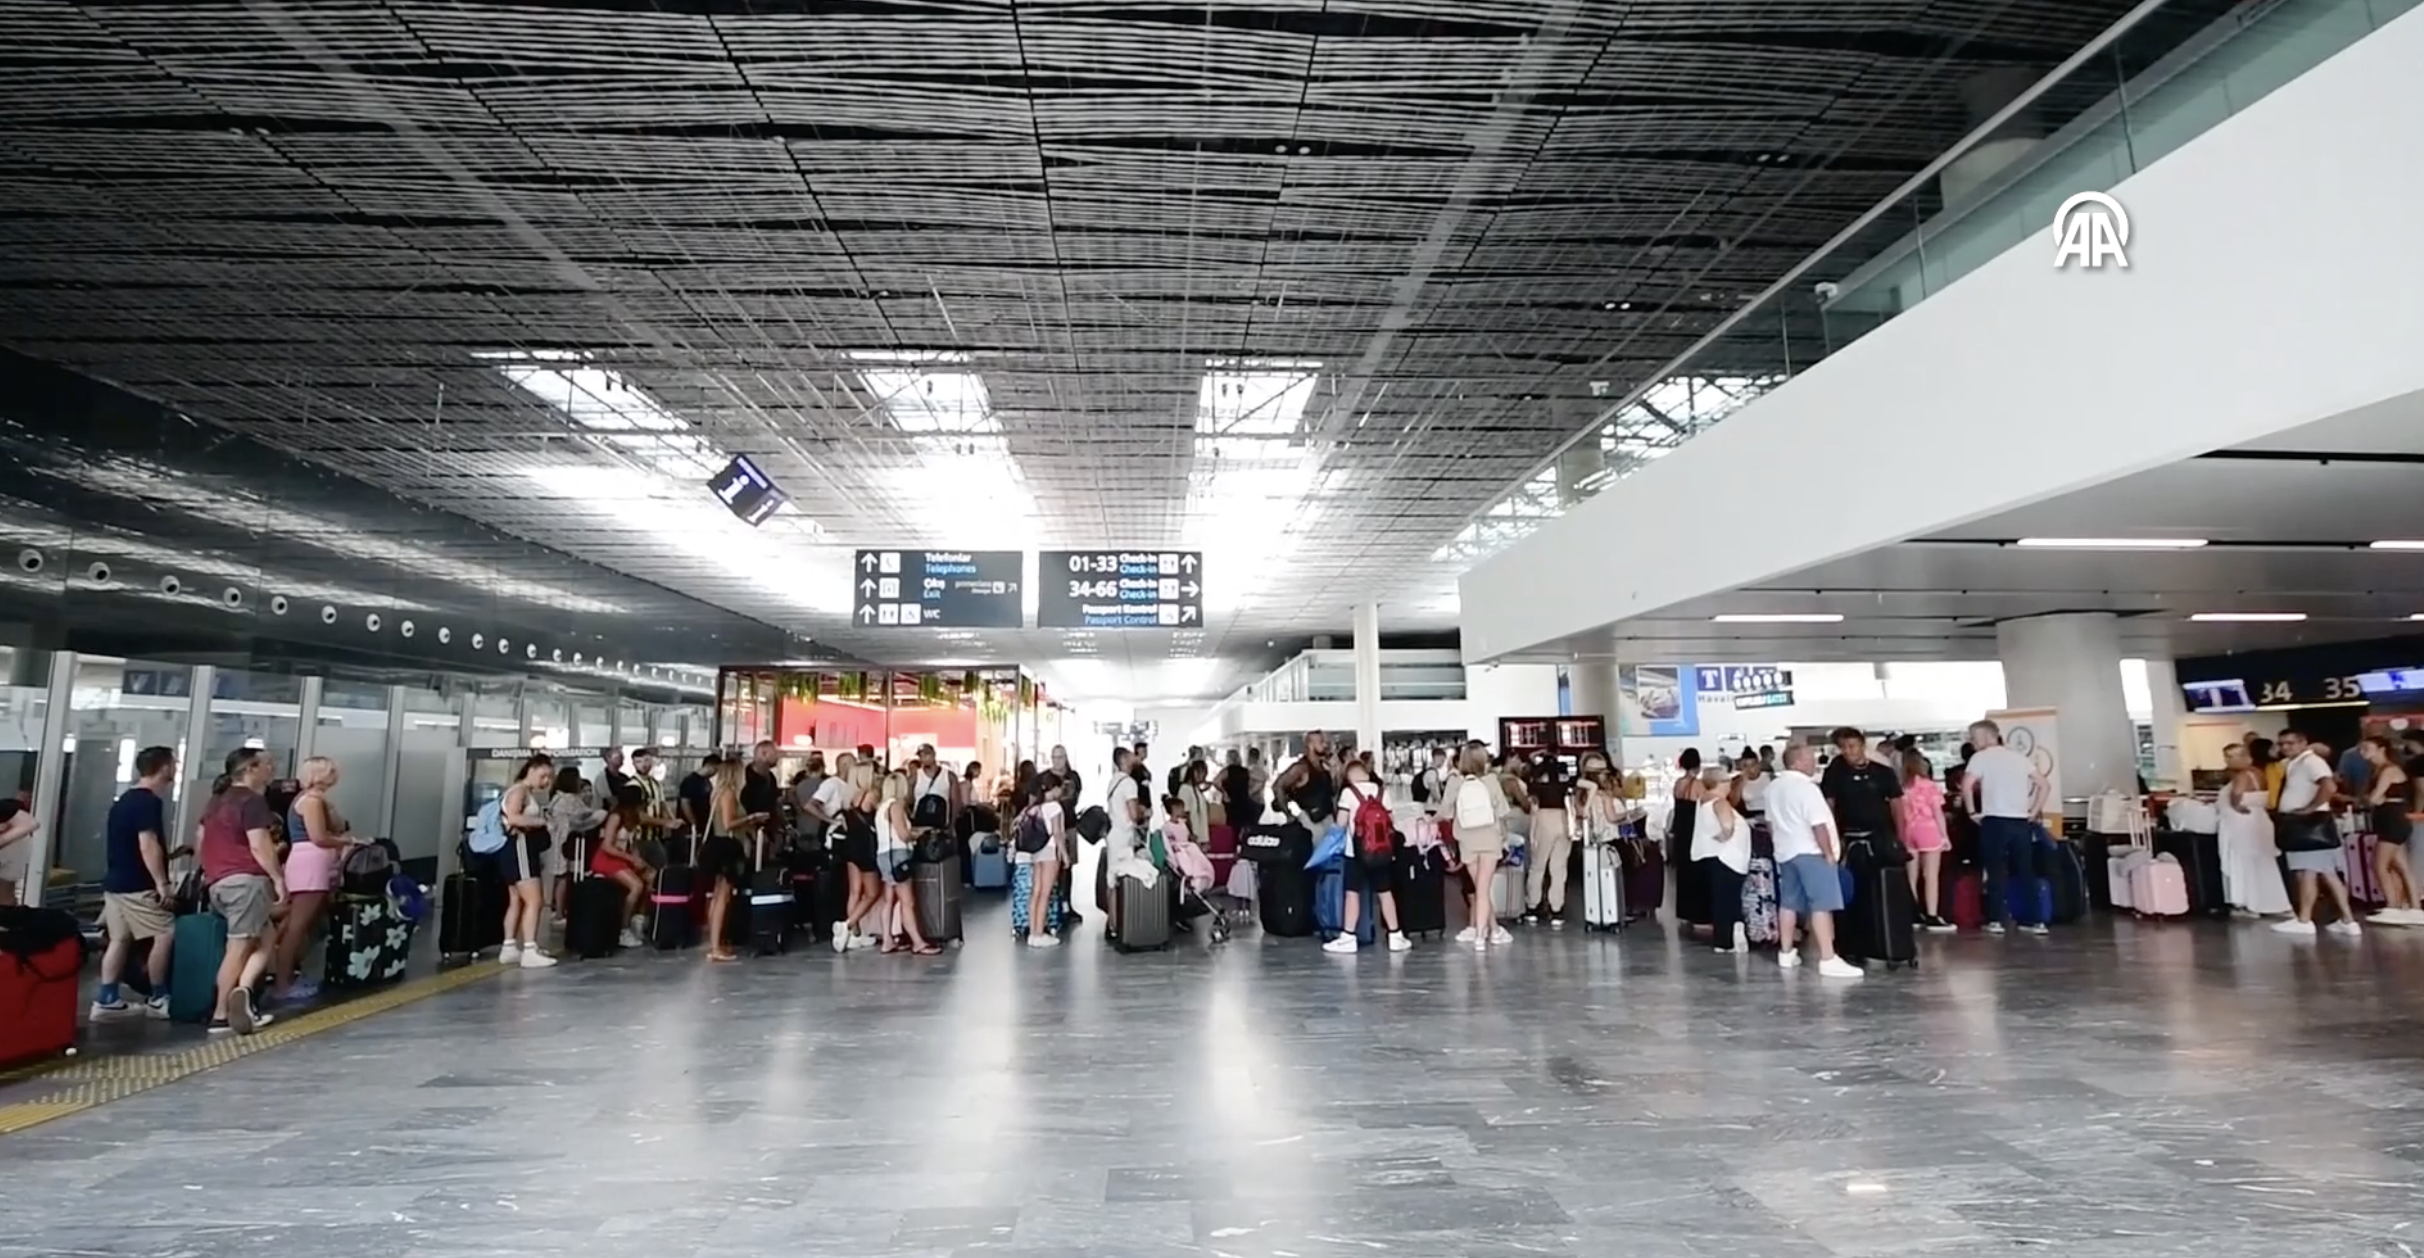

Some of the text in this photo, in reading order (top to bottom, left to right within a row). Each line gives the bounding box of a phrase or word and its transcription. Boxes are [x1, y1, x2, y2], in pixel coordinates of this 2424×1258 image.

[1119, 553, 1157, 563] Check-in
[1069, 555, 1118, 572] 01-33
[925, 563, 977, 575] Telephones
[1119, 564, 1157, 574] Check-in
[1119, 578, 1157, 588] Check-in
[1069, 580, 1118, 597] 34-66
[923, 590, 941, 599] Exit
[1119, 589, 1157, 599] Check-in
[923, 609, 941, 619] WC
[1124, 615, 1157, 625] Control
[2260, 681, 2293, 703] 34
[2324, 676, 2361, 699] 35
